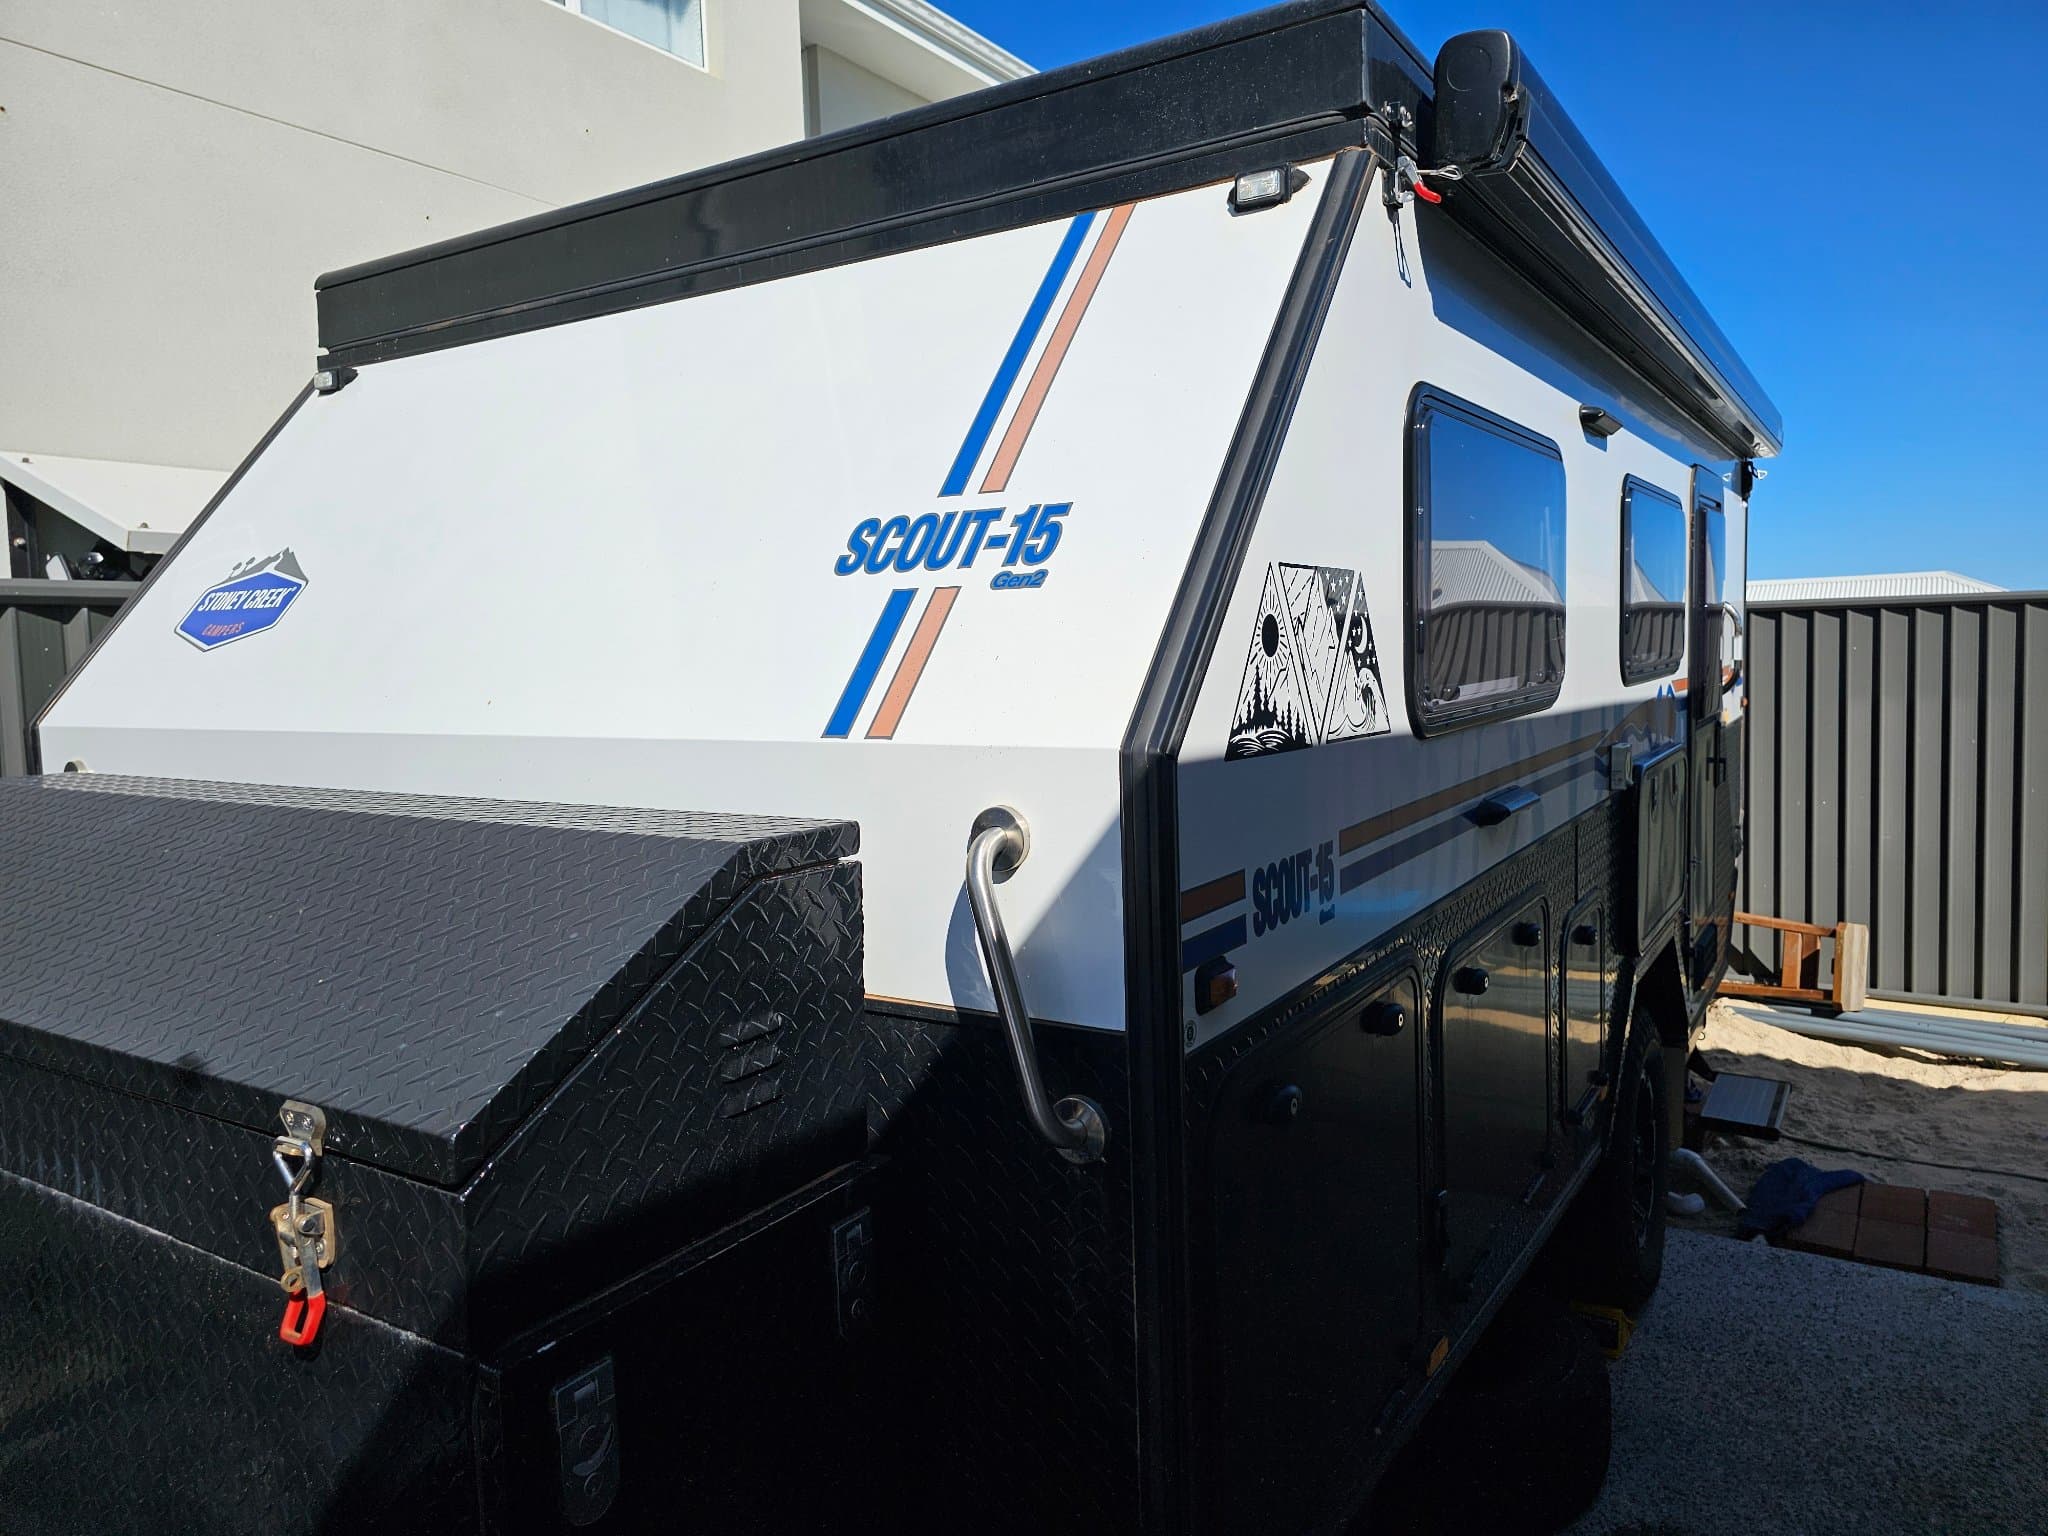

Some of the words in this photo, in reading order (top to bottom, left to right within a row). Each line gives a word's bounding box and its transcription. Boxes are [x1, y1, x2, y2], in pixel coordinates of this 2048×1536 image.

[834, 502, 1073, 576] SCOUT-15
[198, 590, 251, 611] STONEY
[243, 587, 292, 609] CREEK
[990, 569, 1049, 590] Gen2
[1253, 840, 1335, 937] SCOUT-15
